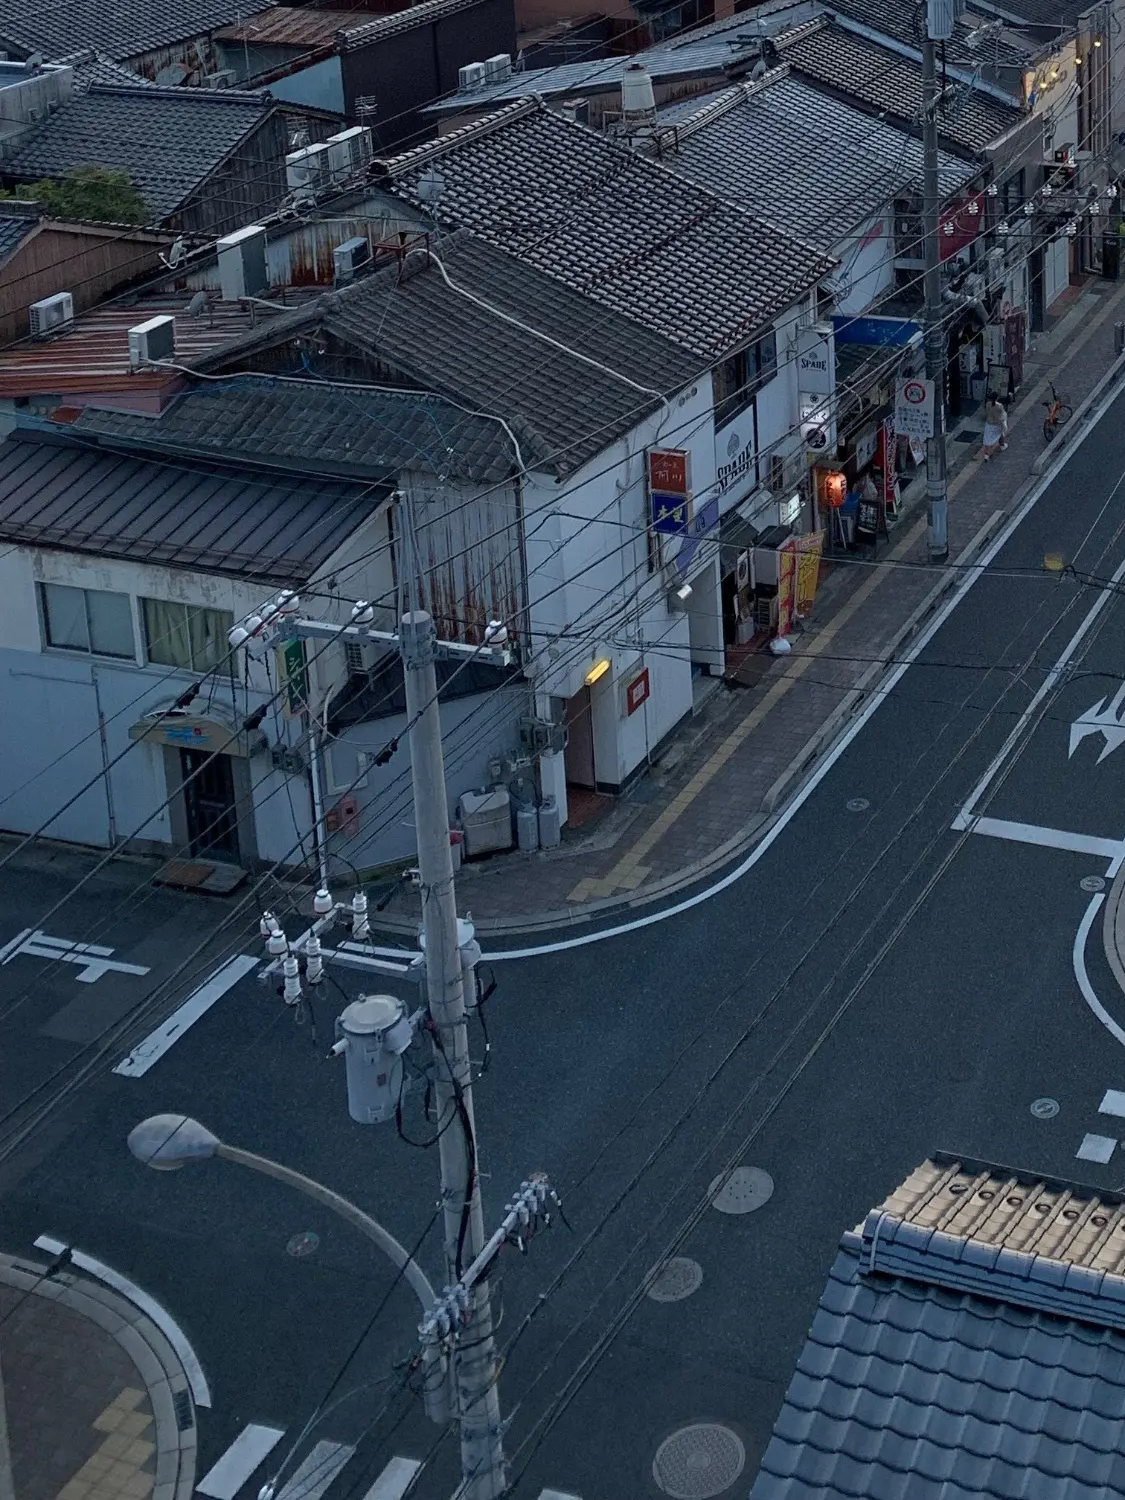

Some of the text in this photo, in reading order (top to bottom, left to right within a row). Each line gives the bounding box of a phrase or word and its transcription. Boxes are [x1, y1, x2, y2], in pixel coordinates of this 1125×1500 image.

[801, 359, 827, 372] SPADE
[798, 549, 822, 603] カレー
